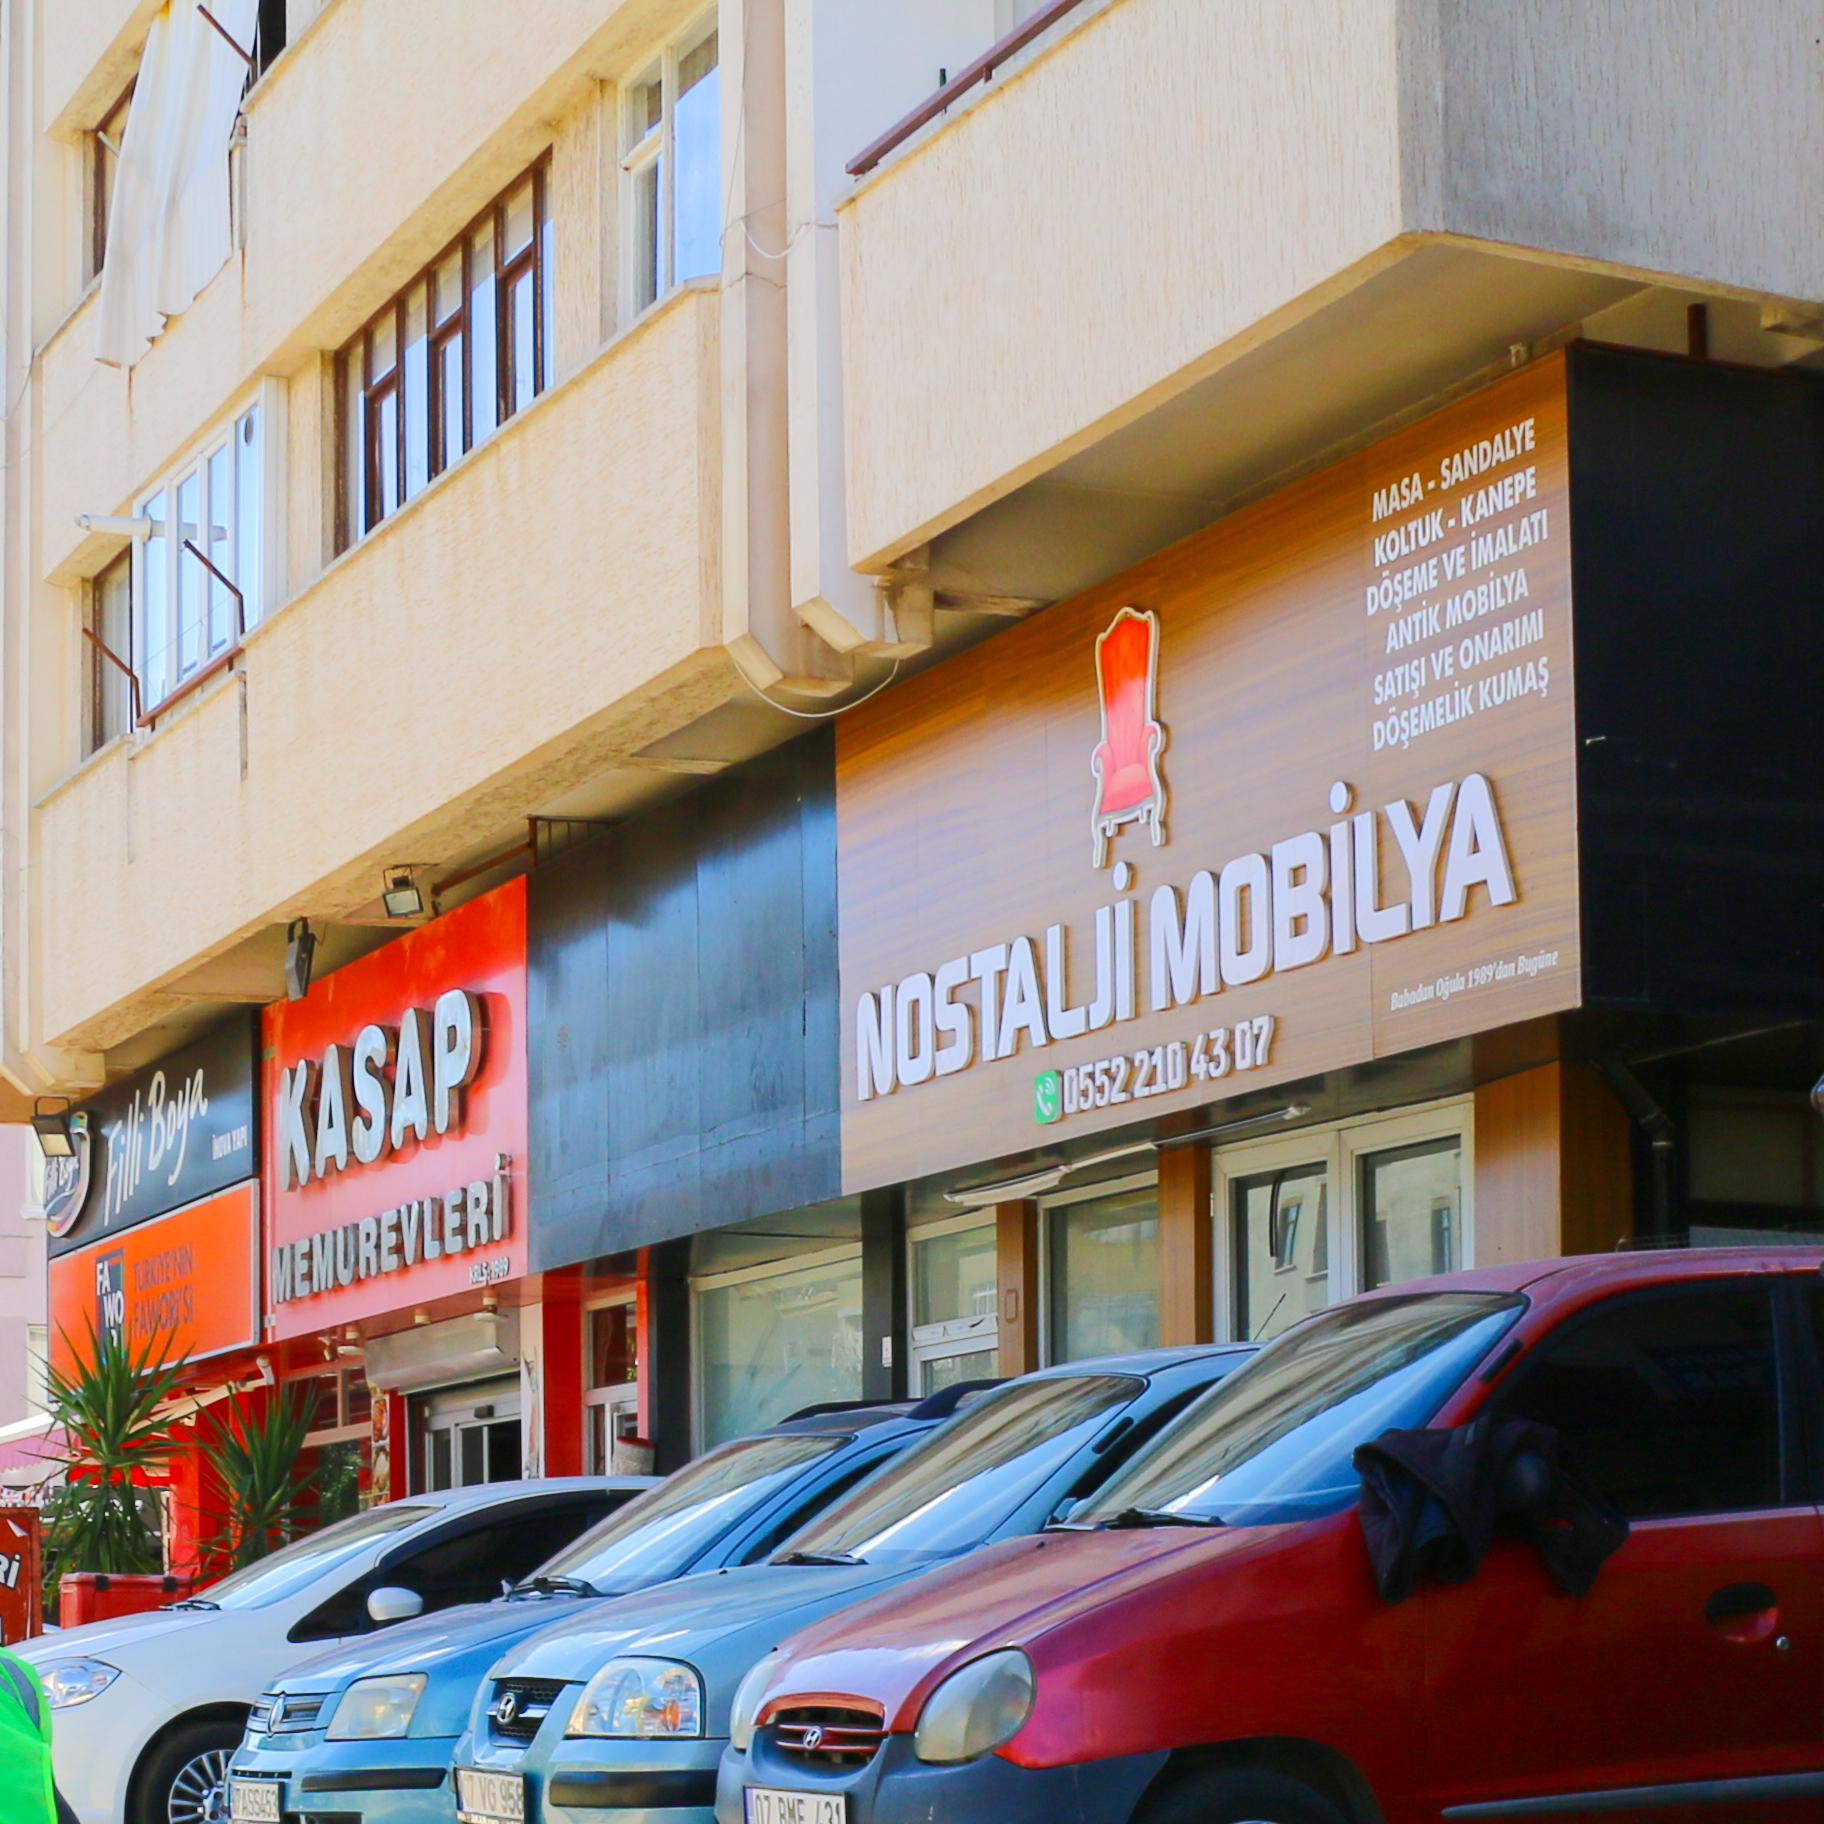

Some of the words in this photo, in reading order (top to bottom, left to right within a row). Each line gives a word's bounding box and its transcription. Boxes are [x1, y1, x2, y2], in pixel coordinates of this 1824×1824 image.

[1372, 472, 1424, 522] MASA
[1440, 417, 1536, 490] SANDALYE
[1373, 508, 1444, 567] KOLTUK
[1460, 465, 1536, 528] KANEPE
[1366, 556, 1438, 616] DÖŞEME
[1441, 544, 1466, 581] VE
[1471, 508, 1548, 571] İMALATI
[1386, 600, 1441, 654] ANTİK
[1445, 567, 1529, 629] MOBİLYA
[1372, 680, 1475, 752] DÖŞEMELİK
[1478, 656, 1549, 711] KUMAŞ
[1373, 656, 1426, 705] SATIŞI
[1430, 644, 1454, 681] VE
[1458, 608, 1544, 670] ONARIMI
[856, 860, 1137, 1101] NOSTALJİ
[1149, 772, 1519, 1012] MOBİLYA
[1390, 984, 1434, 1011] Babadan
[1517, 949, 1559, 977] Bugüne
[280, 988, 478, 1192] KASAP
[1063, 1055, 1131, 1114] 0552
[1133, 1040, 1187, 1099] 210
[1190, 1027, 1230, 1080] 43
[1234, 1014, 1274, 1071] 07
[104, 1089, 145, 1227] Filli
[147, 1068, 209, 1187] Boya
[500, 1778, 523, 1815] 958
